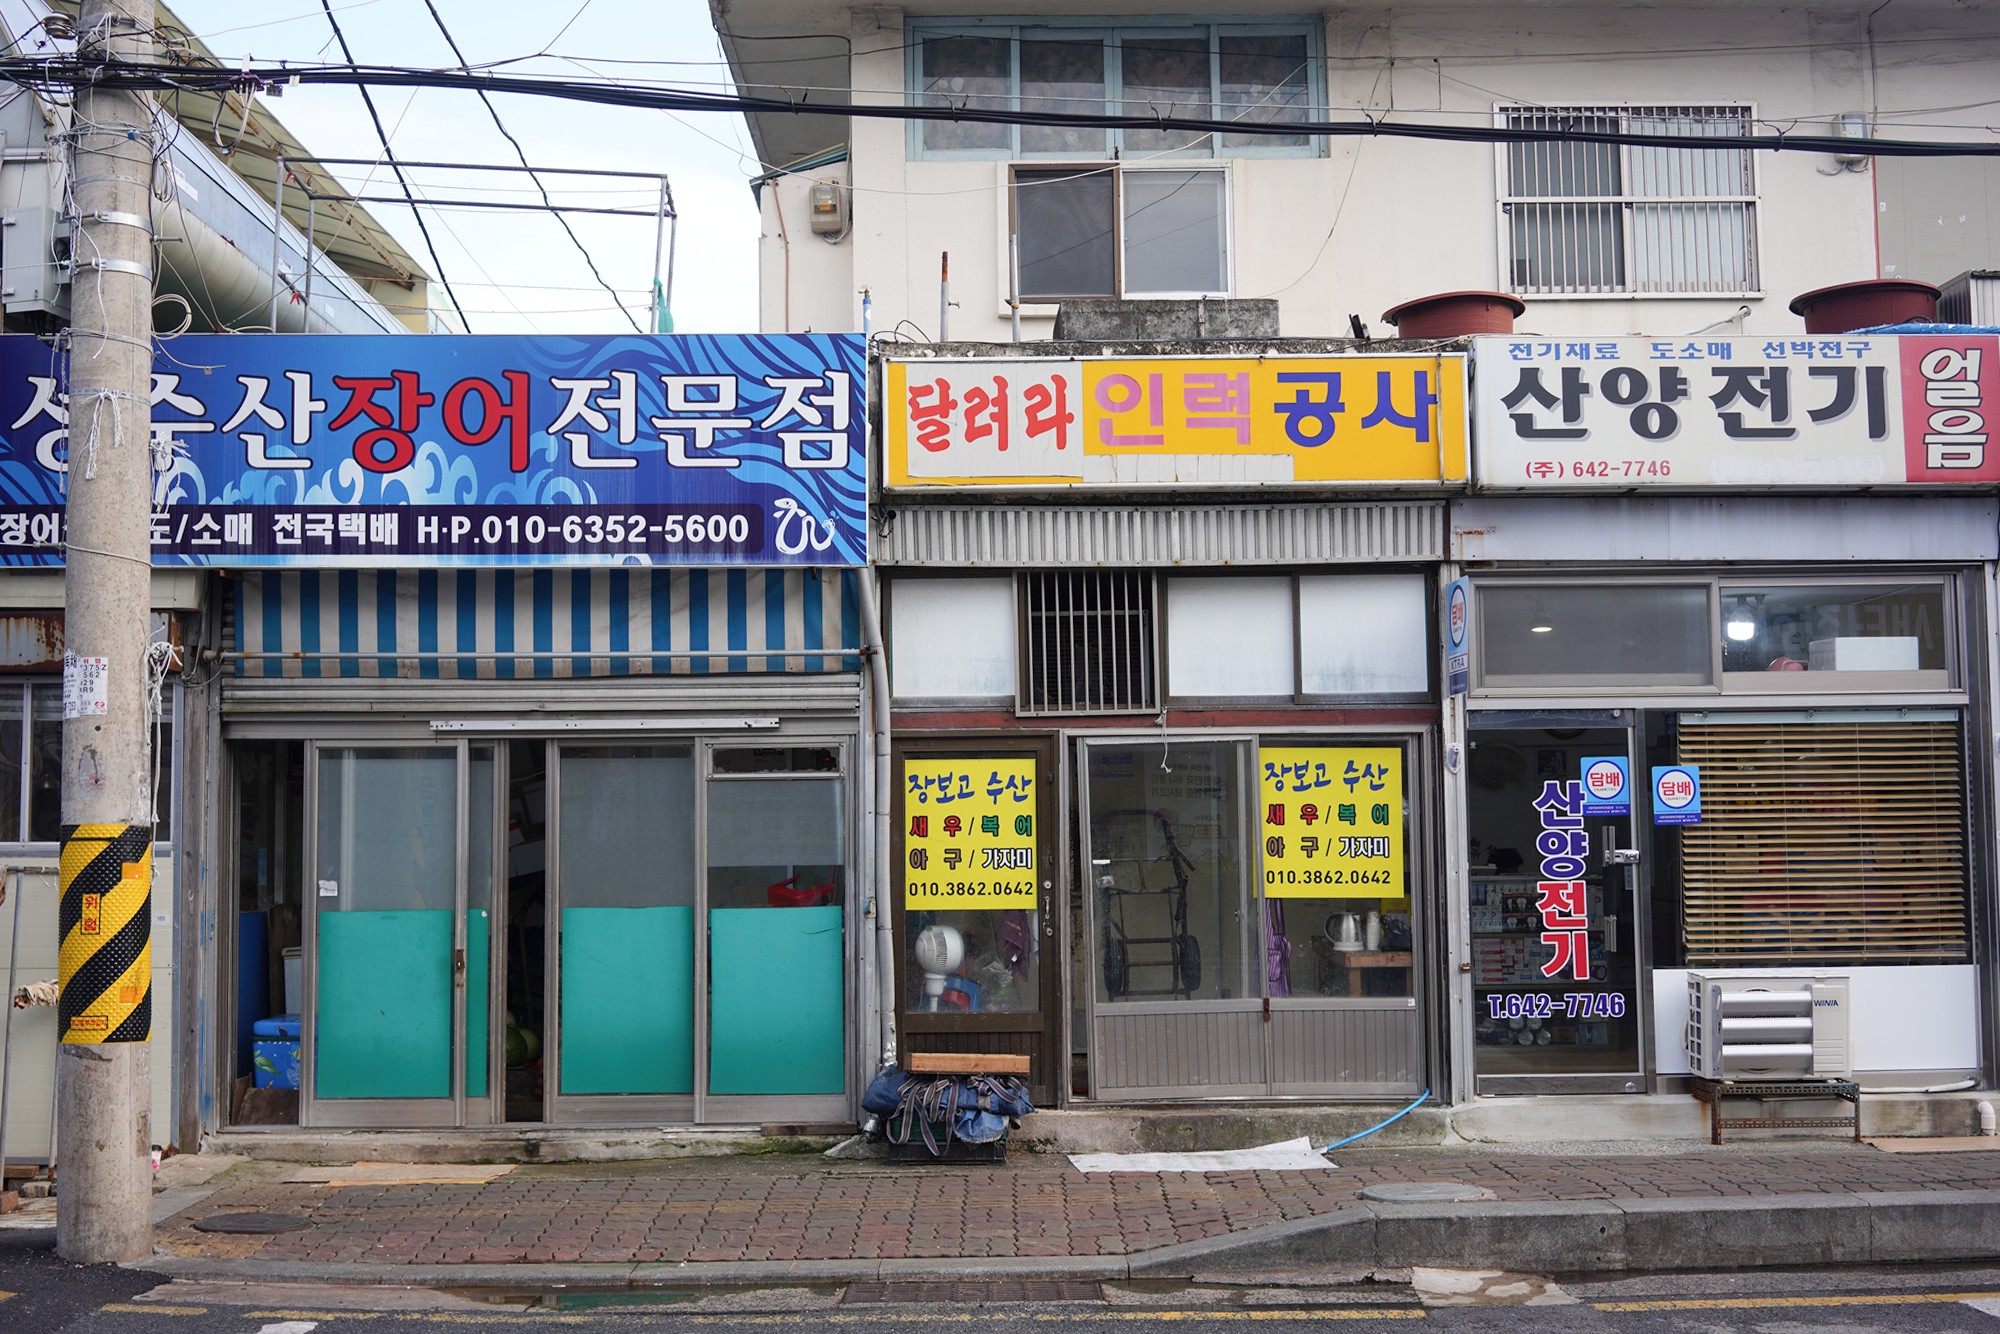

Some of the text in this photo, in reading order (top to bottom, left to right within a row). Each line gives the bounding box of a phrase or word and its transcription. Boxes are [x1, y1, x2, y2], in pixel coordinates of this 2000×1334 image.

[1508, 340, 1873, 361] 전기재료 도소매 선박전구
[907, 373, 1075, 453] 달려라
[1499, 365, 1889, 441] 산양전기
[1919, 347, 1989, 470] 얼음
[1525, 460, 1671, 479] (주) 642-7746
[273, 514, 399, 546] 전국택배
[908, 772, 975, 803] 장보고
[986, 771, 1033, 805] 수산
[1265, 760, 1389, 793] 장보고 수산
[1590, 772, 1620, 787] 담배
[1661, 781, 1691, 796] 담배
[909, 882, 1033, 896] 010.3862.0642
[1266, 870, 1391, 884] 010.3862.0642
[1487, 993, 1625, 1018] T.642-7746
